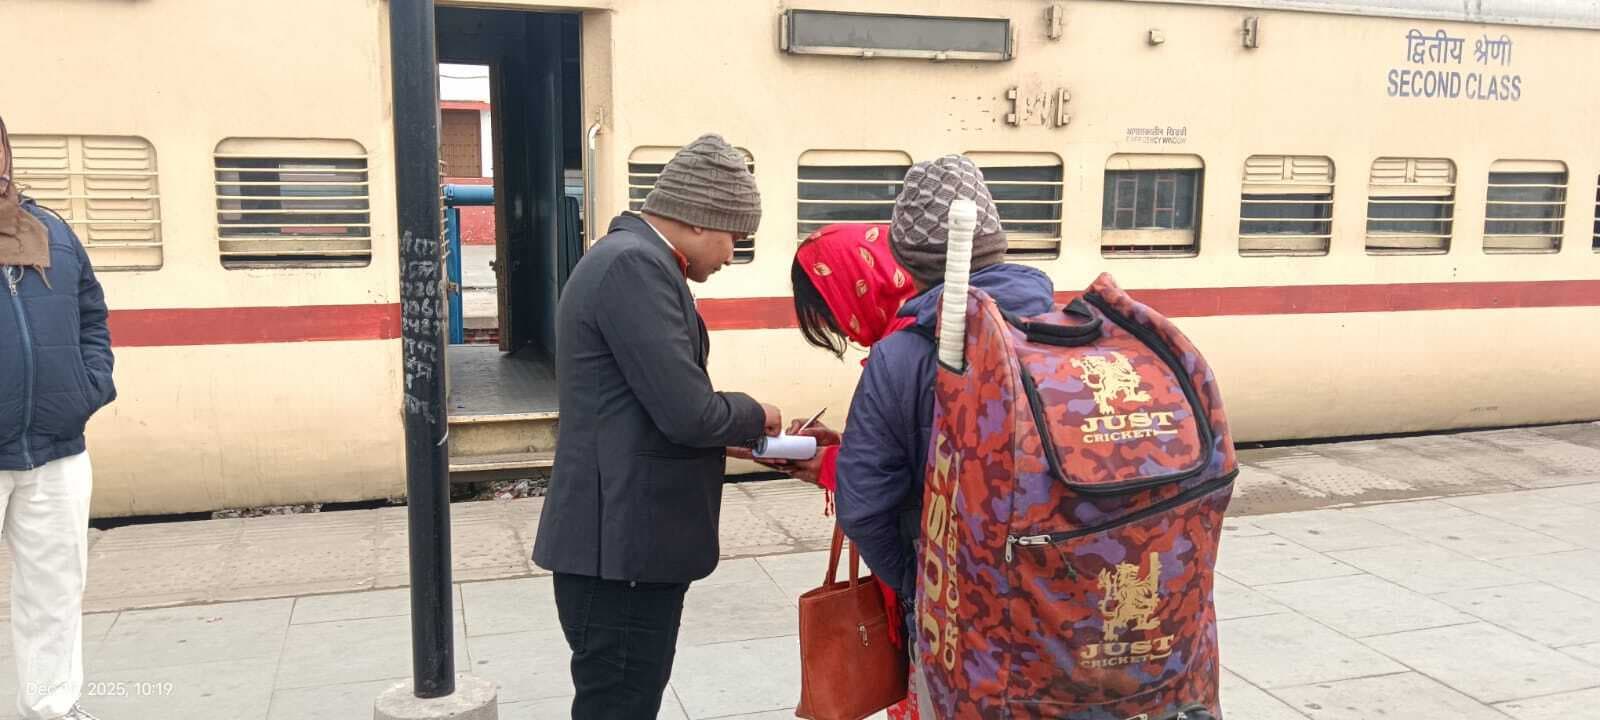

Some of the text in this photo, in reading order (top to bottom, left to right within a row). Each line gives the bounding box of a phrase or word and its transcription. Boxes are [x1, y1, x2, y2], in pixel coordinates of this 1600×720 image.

[1406, 29, 1512, 66] द्वितीय श्रेणी
[1387, 69, 1522, 101] SECOND CLASS
[1080, 411, 1174, 433] JUST
[1083, 429, 1153, 443] CRICKET
[922, 434, 950, 656] JUST
[943, 508, 960, 671] CRICKET
[1080, 634, 1174, 659] JUST
[1080, 655, 1148, 669] CRICKET
